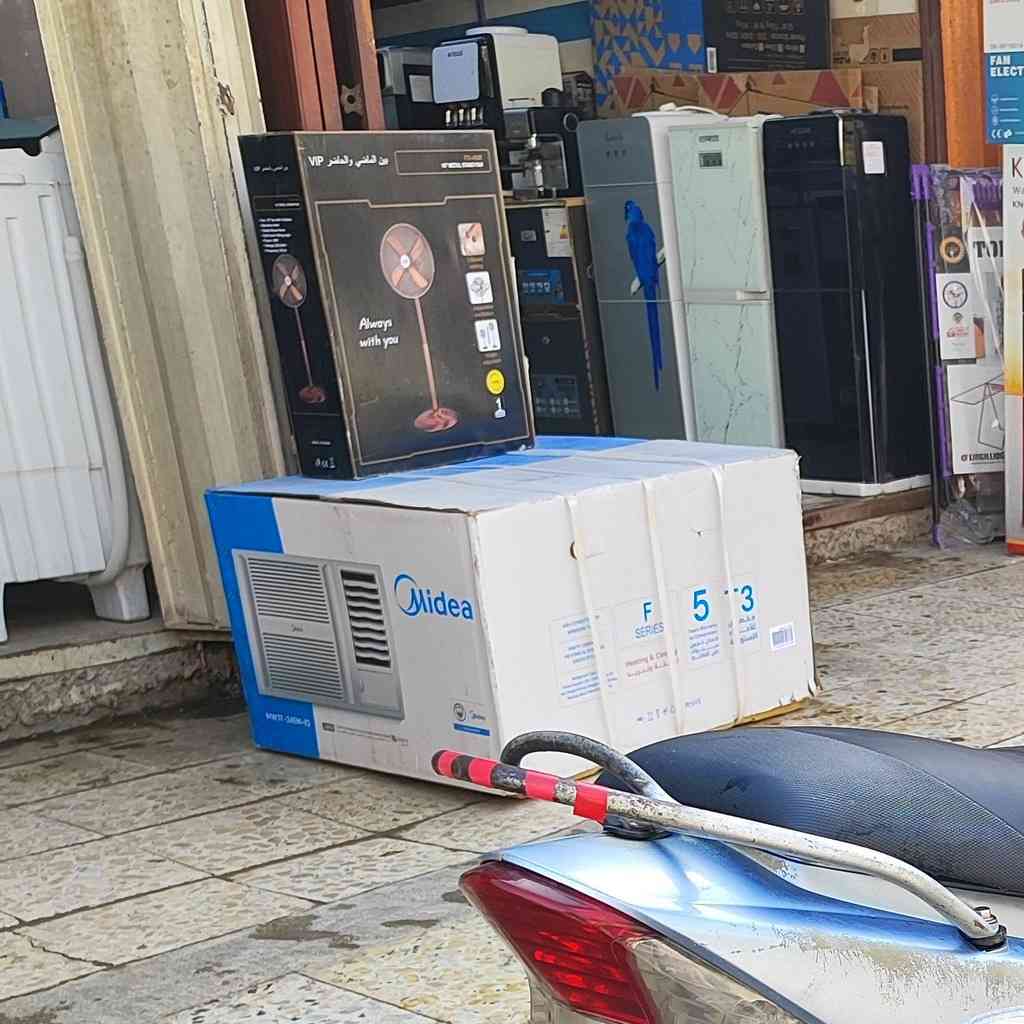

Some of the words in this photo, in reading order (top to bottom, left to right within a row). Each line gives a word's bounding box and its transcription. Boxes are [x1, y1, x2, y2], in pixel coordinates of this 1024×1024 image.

[990, 55, 1011, 65] FAN
[308, 155, 324, 167] VIP
[359, 317, 393, 332] Always
[359, 335, 381, 348] with
[382, 335, 400, 349] you
[394, 574, 474, 620] Midea
[693, 588, 710, 622] 5
[635, 623, 665, 639] SERIES
